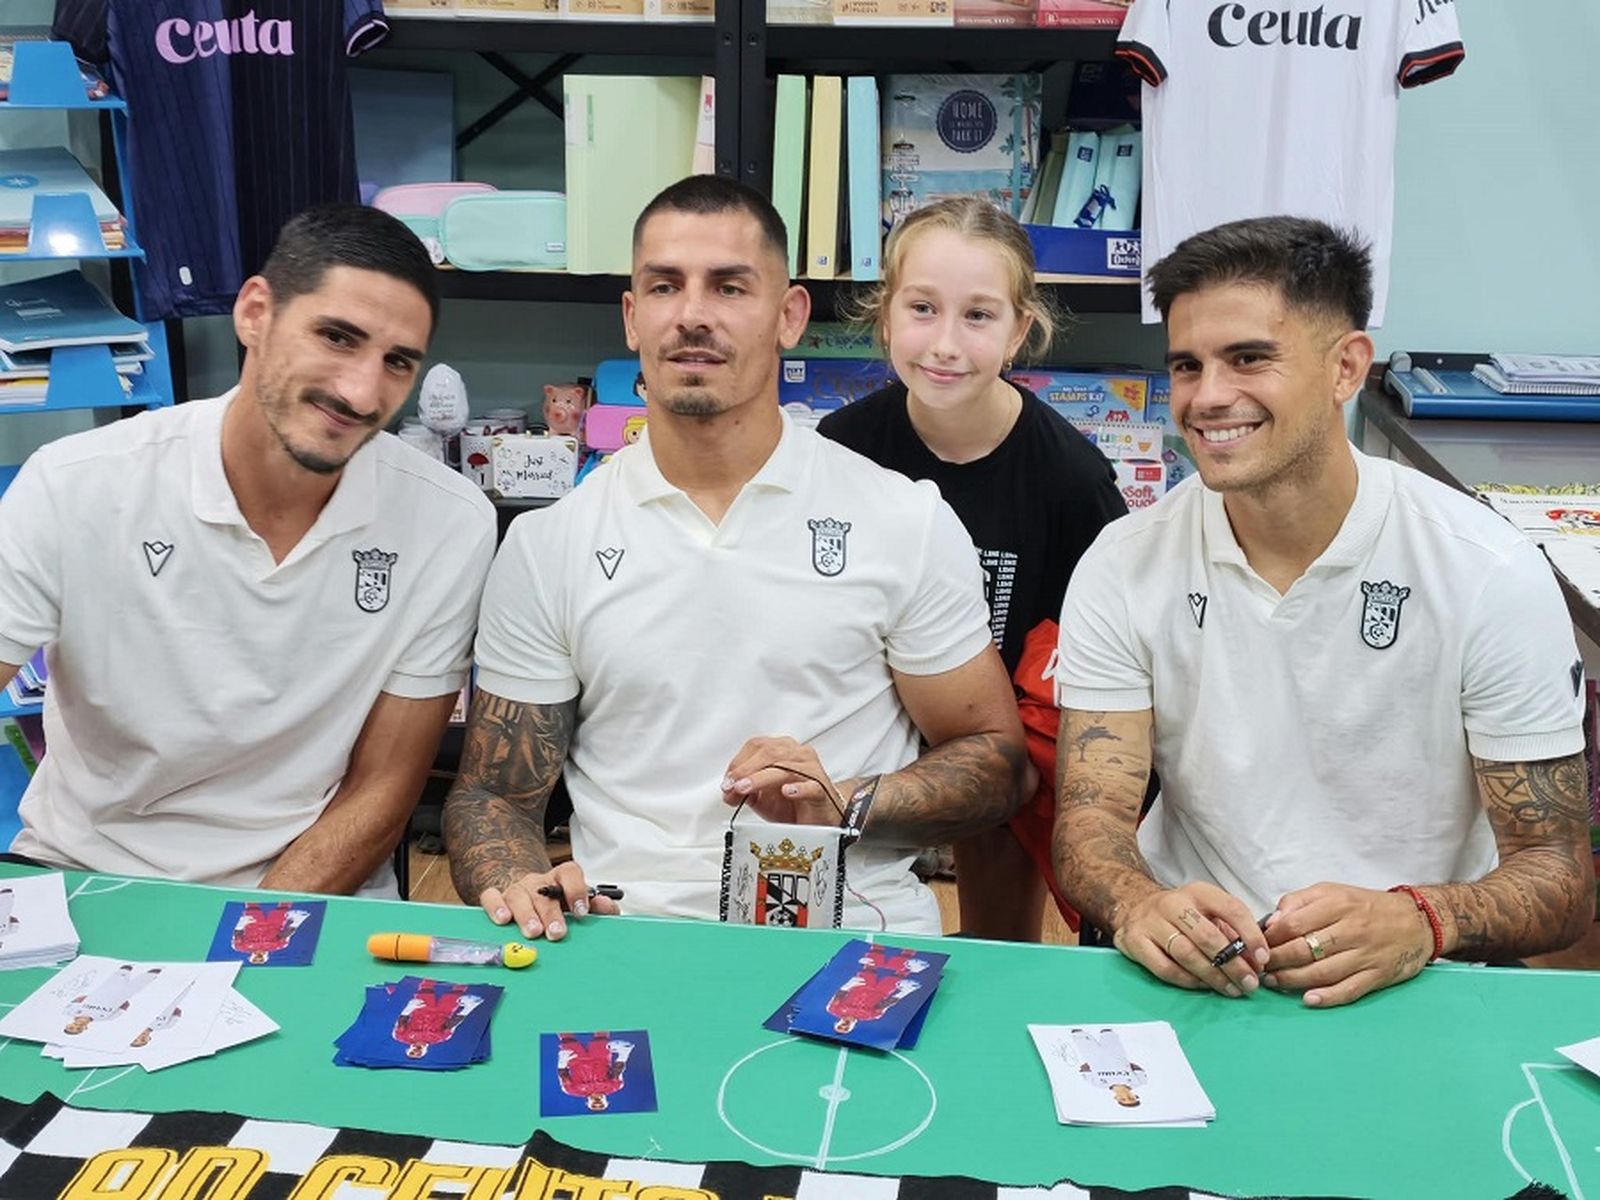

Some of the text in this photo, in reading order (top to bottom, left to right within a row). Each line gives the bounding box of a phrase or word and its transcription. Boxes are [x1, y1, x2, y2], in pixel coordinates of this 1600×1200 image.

[155, 9, 294, 64] Ceuta
[1208, 3, 1362, 50] Ceuta
[287, 1154, 720, 1200] CEUT
